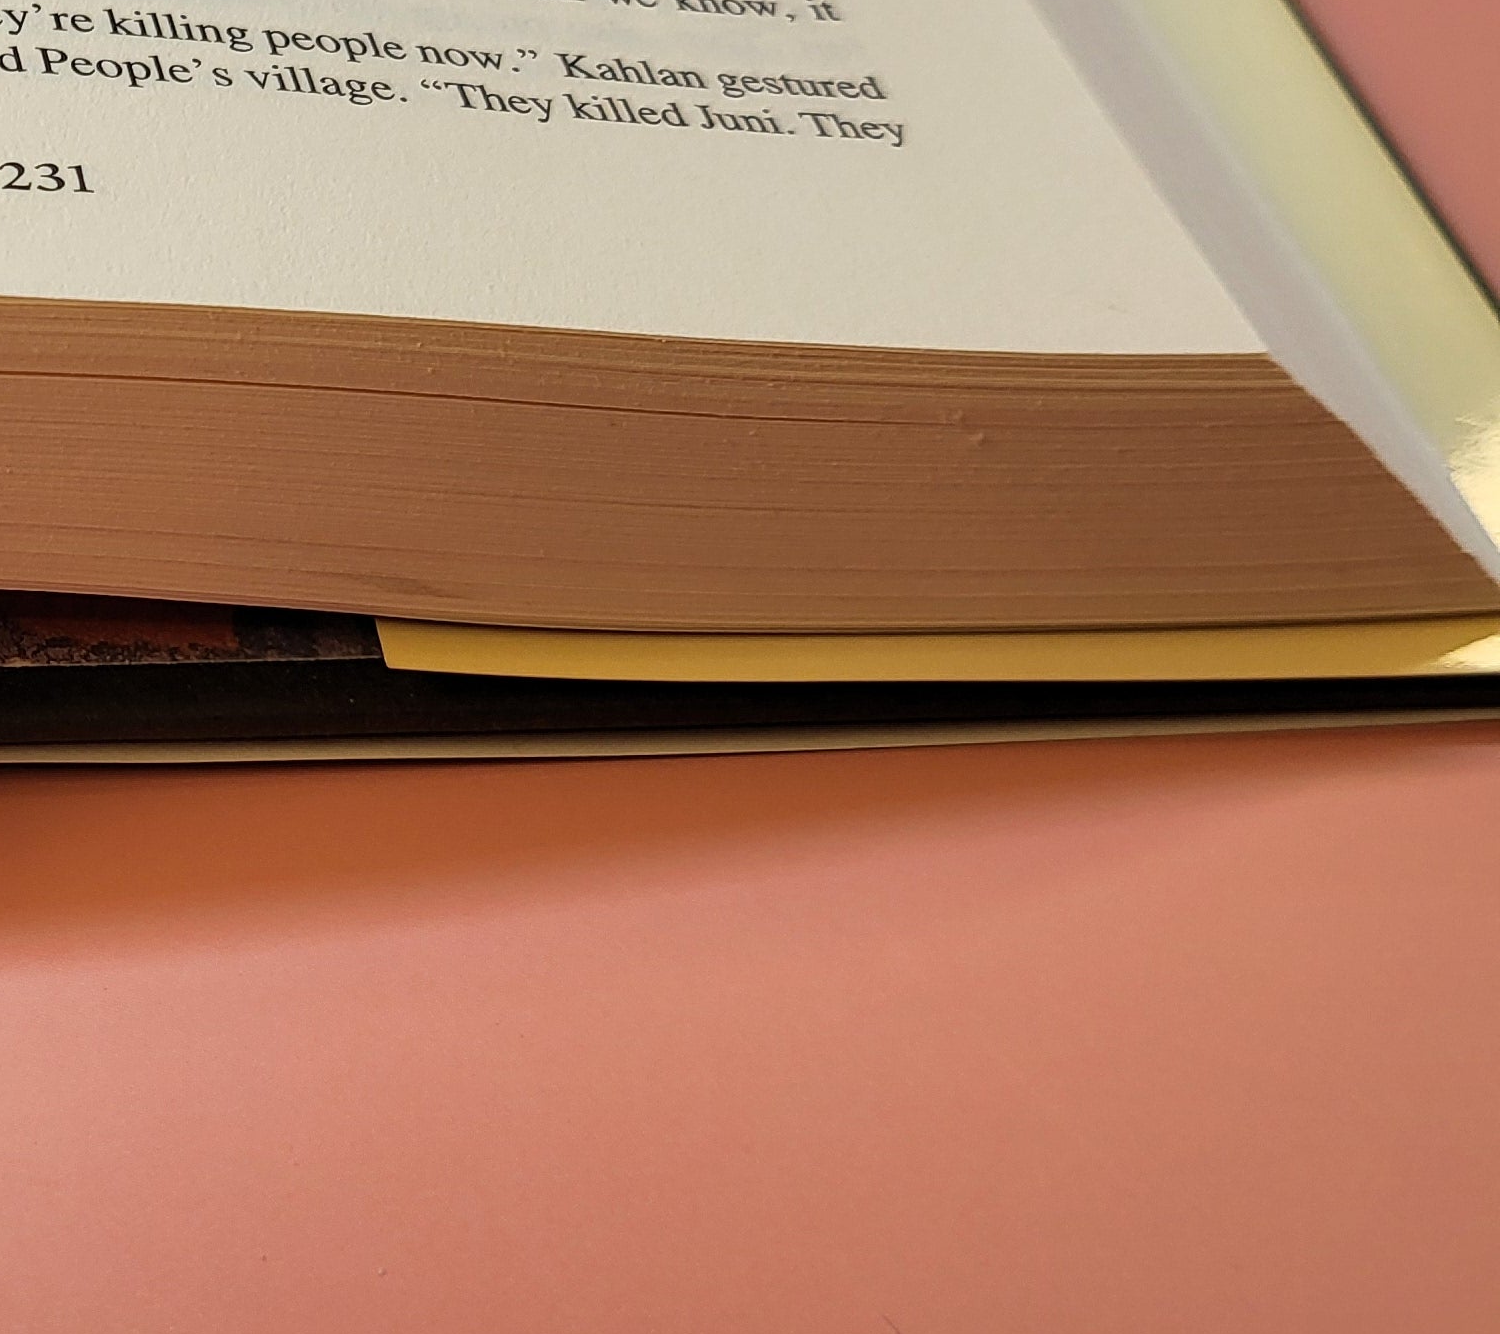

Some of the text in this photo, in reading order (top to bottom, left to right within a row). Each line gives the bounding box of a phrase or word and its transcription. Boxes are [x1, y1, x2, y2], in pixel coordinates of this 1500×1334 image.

[35, 48, 234, 89] People’s
[244, 65, 408, 106] village.
[421, 79, 554, 124] “They
[563, 94, 687, 128] killed
[699, 105, 795, 137] Juni.
[798, 111, 905, 148] They
[101, 8, 255, 53] killing
[262, 30, 406, 70] people
[418, 33, 538, 73] now.”
[552, 52, 711, 90] Kahlan
[716, 73, 889, 100] gestured
